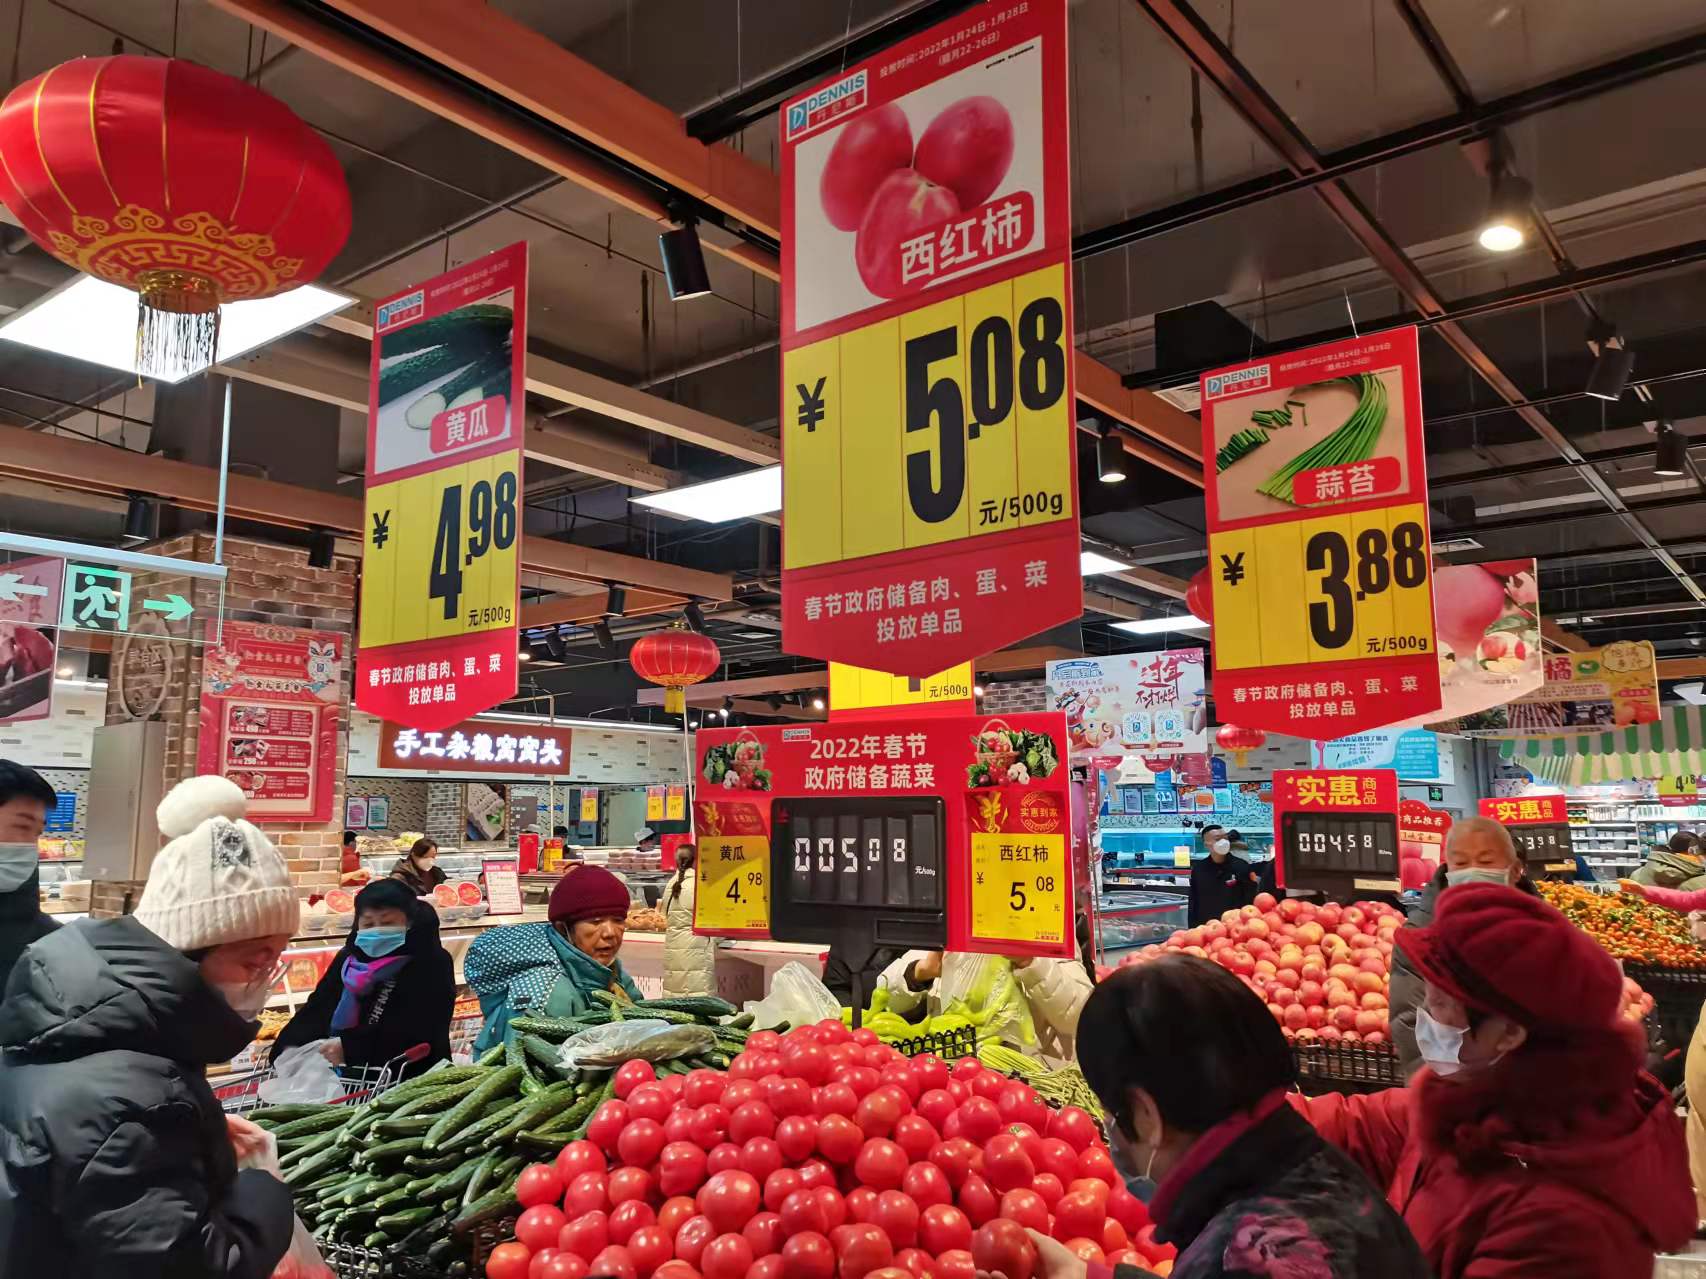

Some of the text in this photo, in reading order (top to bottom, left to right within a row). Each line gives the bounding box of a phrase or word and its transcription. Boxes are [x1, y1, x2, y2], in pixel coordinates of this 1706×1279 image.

[808, 75, 865, 111] DENNIS
[900, 201, 1022, 285] 西红柿
[1222, 366, 1268, 385] DENNIS
[446, 404, 488, 446] 黄瓜
[905, 296, 1066, 524] 5.08
[1315, 463, 1376, 500] 蒜苔
[979, 491, 1064, 526] 元/500g
[429, 471, 517, 620] 4.98
[1306, 521, 1427, 649] 3.88
[468, 606, 512, 627] 元/500g
[876, 608, 962, 643] 投放单品
[1366, 635, 1428, 653] 元/500g
[408, 684, 456, 706] 投放单品
[929, 684, 969, 698] 元/500g
[1289, 700, 1356, 719] 投放单品
[394, 729, 563, 766] 手工杂粮窝窝头
[810, 733, 928, 759] 2022年春节
[804, 763, 936, 791] 政府储备蔬菜
[1296, 776, 1377, 806] 实惠 商品
[1497, 800, 1543, 821] 实惠
[720, 845, 745, 862] 黄瓜
[1000, 844, 1049, 863] 西红柿
[726, 872, 763, 904] 4.98
[1010, 876, 1055, 912] 5.08
